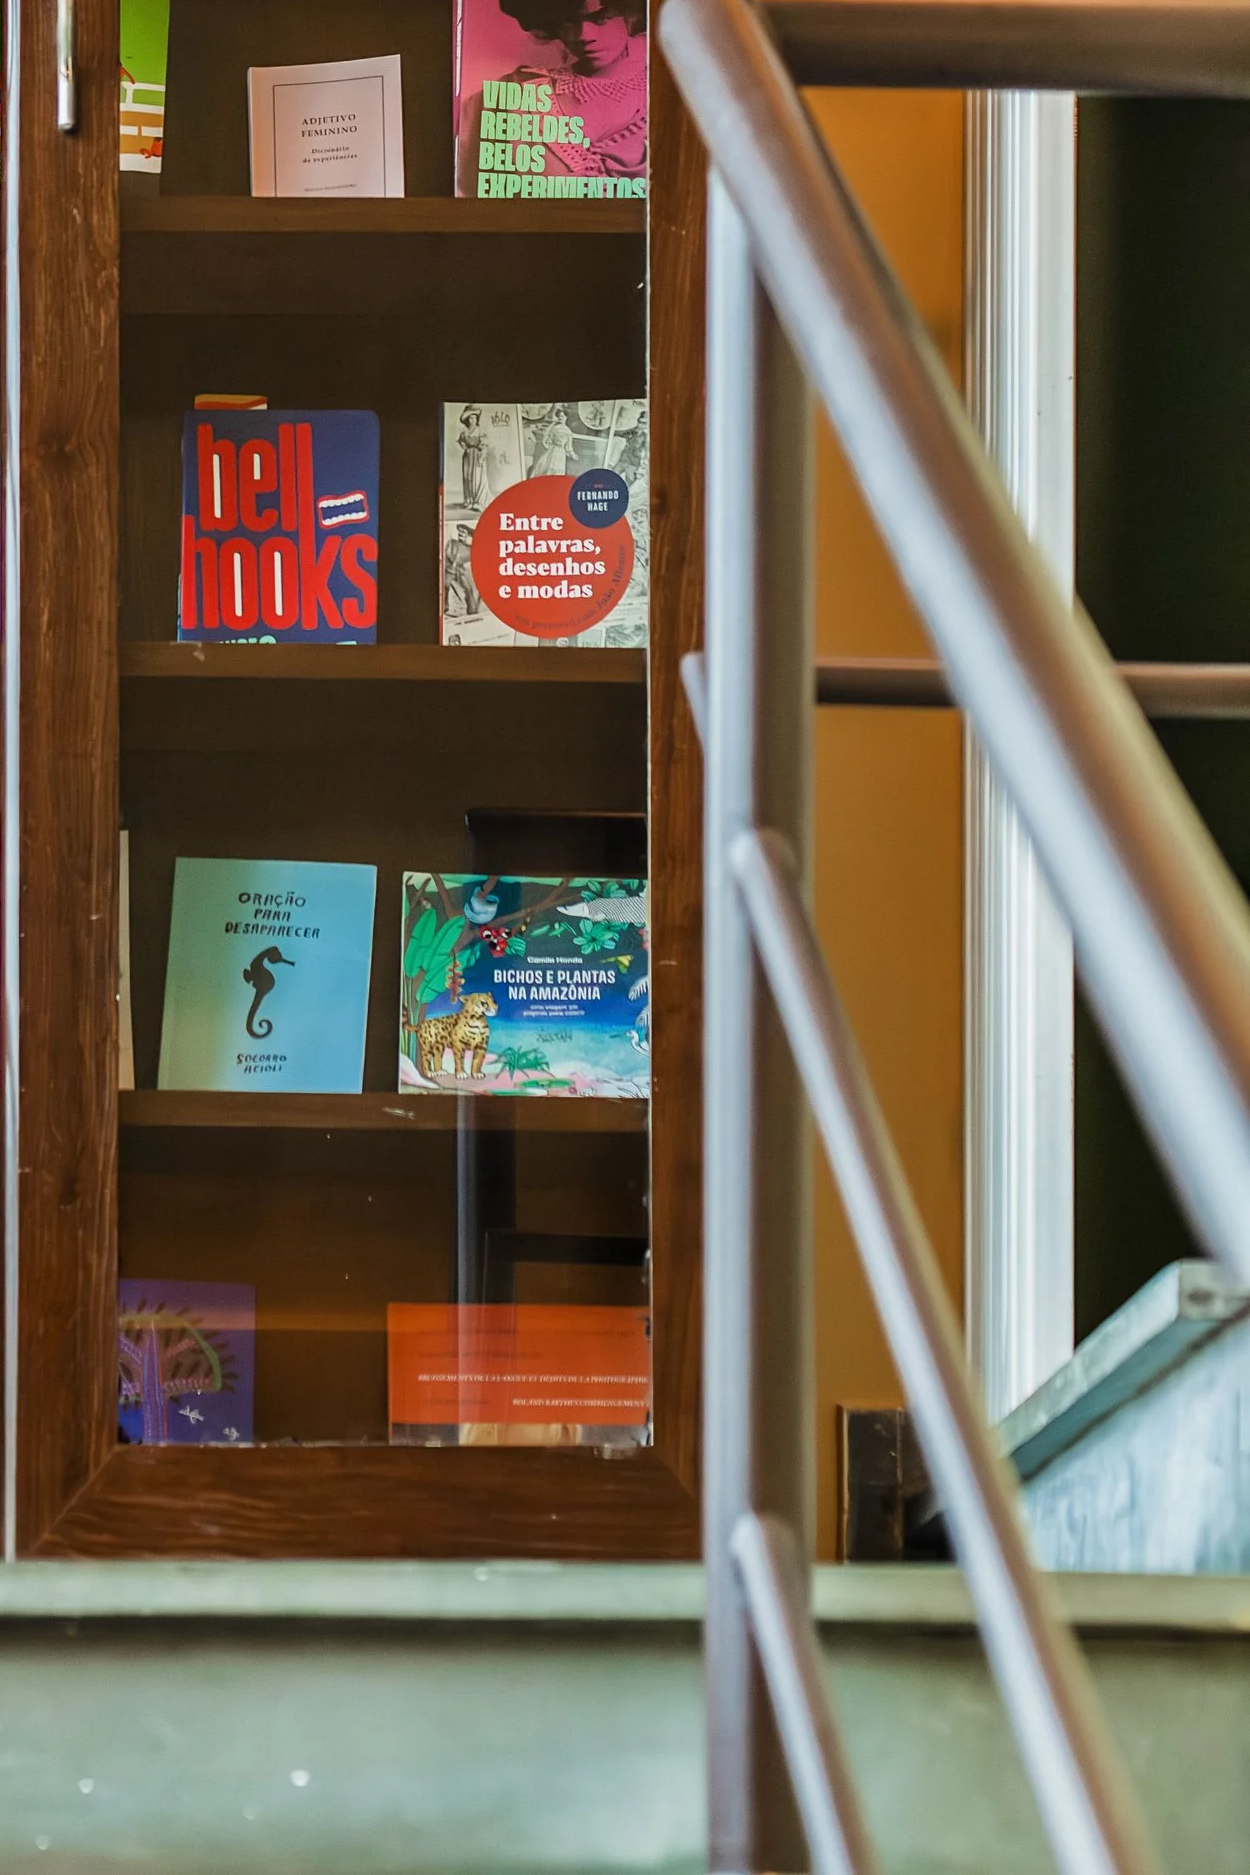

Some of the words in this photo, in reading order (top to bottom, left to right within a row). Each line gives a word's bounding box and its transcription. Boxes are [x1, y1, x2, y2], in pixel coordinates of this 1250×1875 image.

[482, 80, 553, 113] VIDAS
[302, 113, 356, 126] ADJETIVO
[302, 125, 358, 137] FEMININO
[480, 111, 591, 148] REBELDES,
[478, 142, 546, 173] BELOS
[477, 172, 647, 198] EXPERIMENTOS
[198, 423, 315, 532] bell
[577, 491, 619, 501] FERNANDO
[587, 502, 608, 511] HAGE
[499, 513, 564, 531] Entre
[499, 536, 600, 557] palavras,
[181, 514, 378, 630] hooks
[499, 558, 606, 576] desenhos
[498, 585, 511, 599] e
[518, 581, 593, 599] modas
[238, 891, 306, 908] ORAÇÃO
[253, 909, 291, 921] PARA
[224, 922, 320, 939] DESAPARECER
[494, 970, 542, 984] BICHOS
[547, 971, 554, 983] E
[557, 970, 616, 984] PLANTAS
[508, 987, 527, 1000] NA
[530, 984, 601, 1001] AMAZÔNIA
[237, 1054, 287, 1064] SOCORRO
[244, 1064, 282, 1074] ACIOLI
